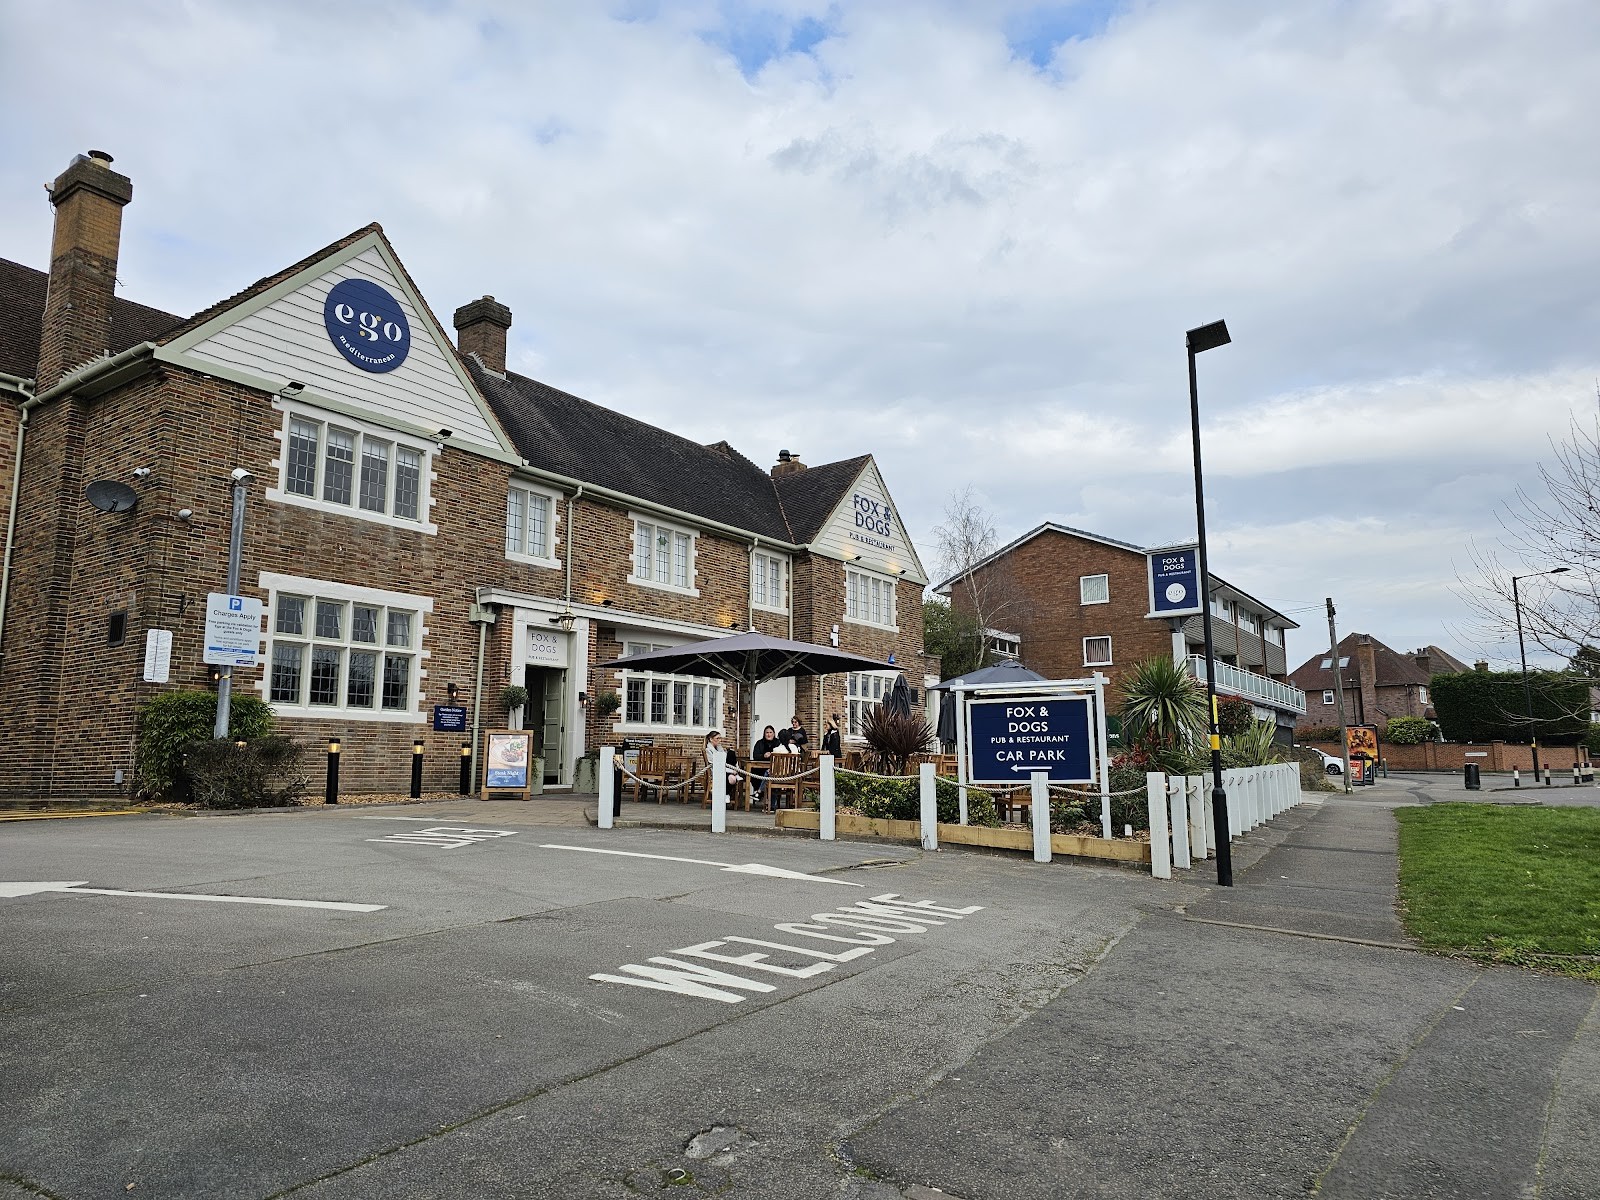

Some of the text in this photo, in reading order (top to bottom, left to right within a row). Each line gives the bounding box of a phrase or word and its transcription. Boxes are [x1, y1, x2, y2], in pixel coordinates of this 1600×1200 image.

[334, 304, 402, 342] ego
[340, 335, 396, 364] mediterranean
[854, 494, 890, 521] FOX &
[856, 511, 890, 536] DOGS
[850, 532, 859, 540] PUB
[1164, 563, 1184, 571] DOGS
[213, 610, 238, 618] Charges
[532, 633, 549, 642] FOX
[532, 644, 556, 653] DOGS
[1006, 706, 1049, 718] FOX &
[1008, 722, 1049, 733] DOGS
[1016, 735, 1069, 743] RESTAURANT
[996, 750, 1066, 761] CAR PARK
[587, 893, 986, 1004] WELCOME
